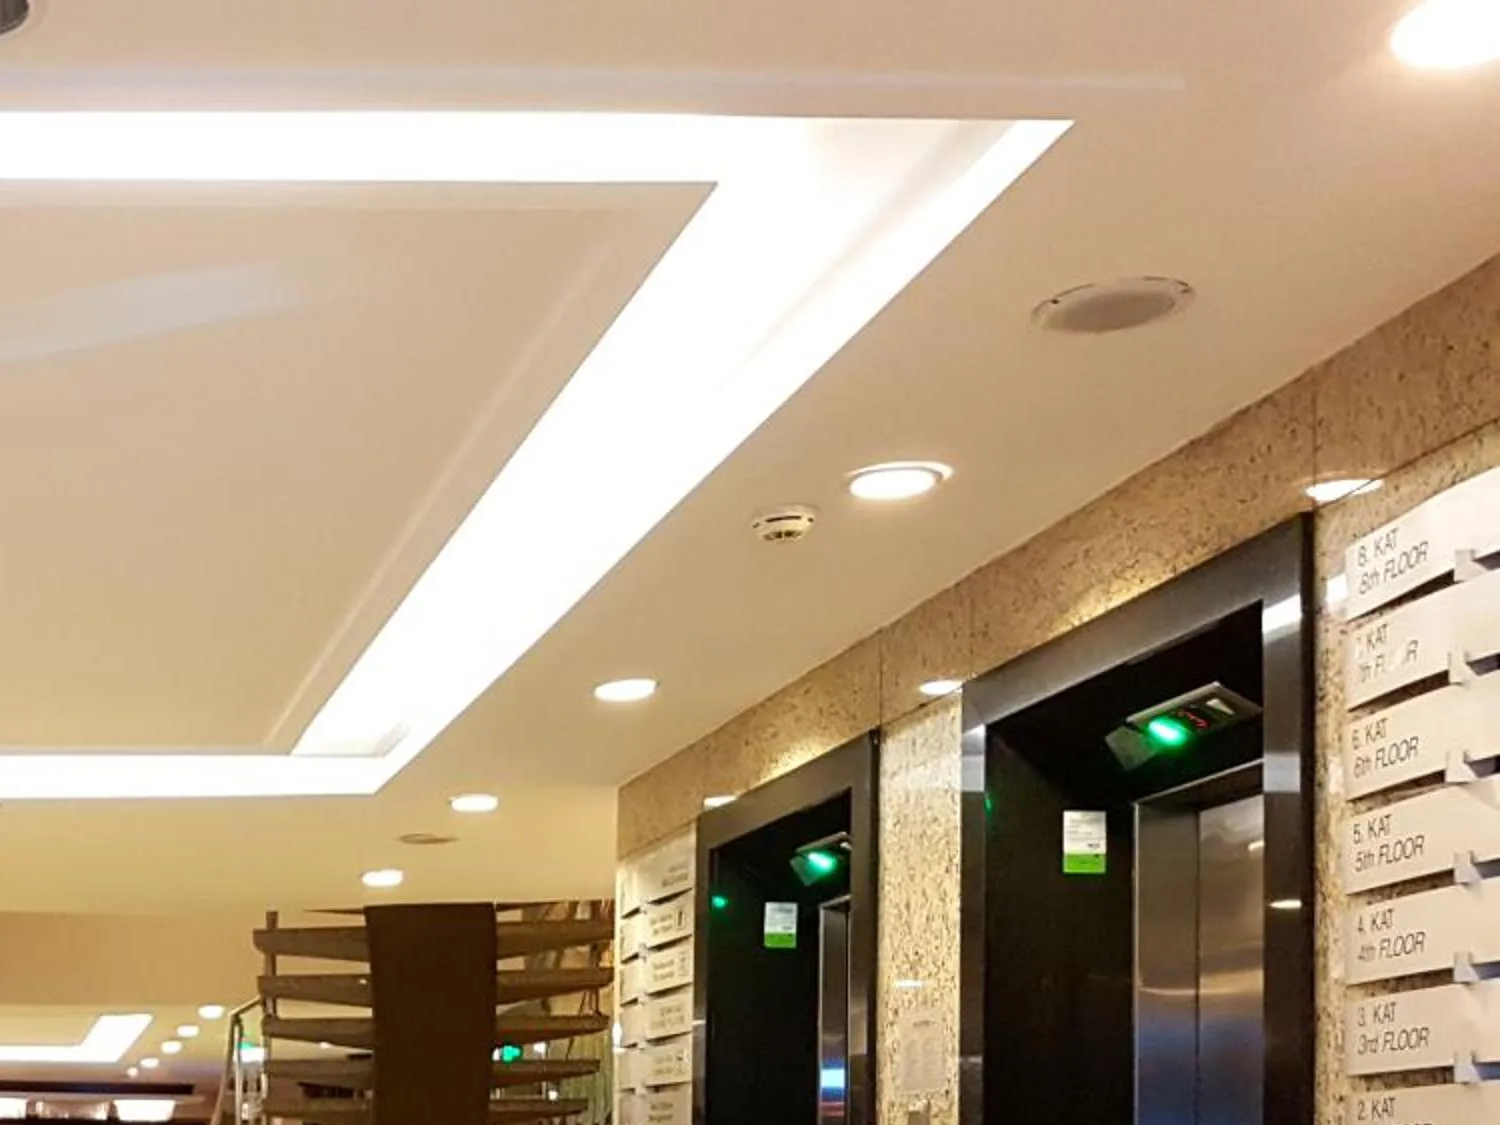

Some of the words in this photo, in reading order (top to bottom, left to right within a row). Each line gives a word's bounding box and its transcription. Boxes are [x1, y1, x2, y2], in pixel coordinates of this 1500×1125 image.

[1373, 527, 1398, 557] KAT
[1384, 541, 1428, 582] FLOOR
[1365, 718, 1388, 744] KAT
[1375, 736, 1418, 770] FLOOR
[1368, 814, 1392, 838] KAT
[1379, 835, 1425, 865] FLOOR
[1371, 908, 1394, 932] KAT
[1379, 931, 1426, 959] FLOOR
[1373, 1002, 1397, 1024] KAT
[1382, 1026, 1430, 1052] FLOOR
[1372, 1097, 1396, 1120] KAT
